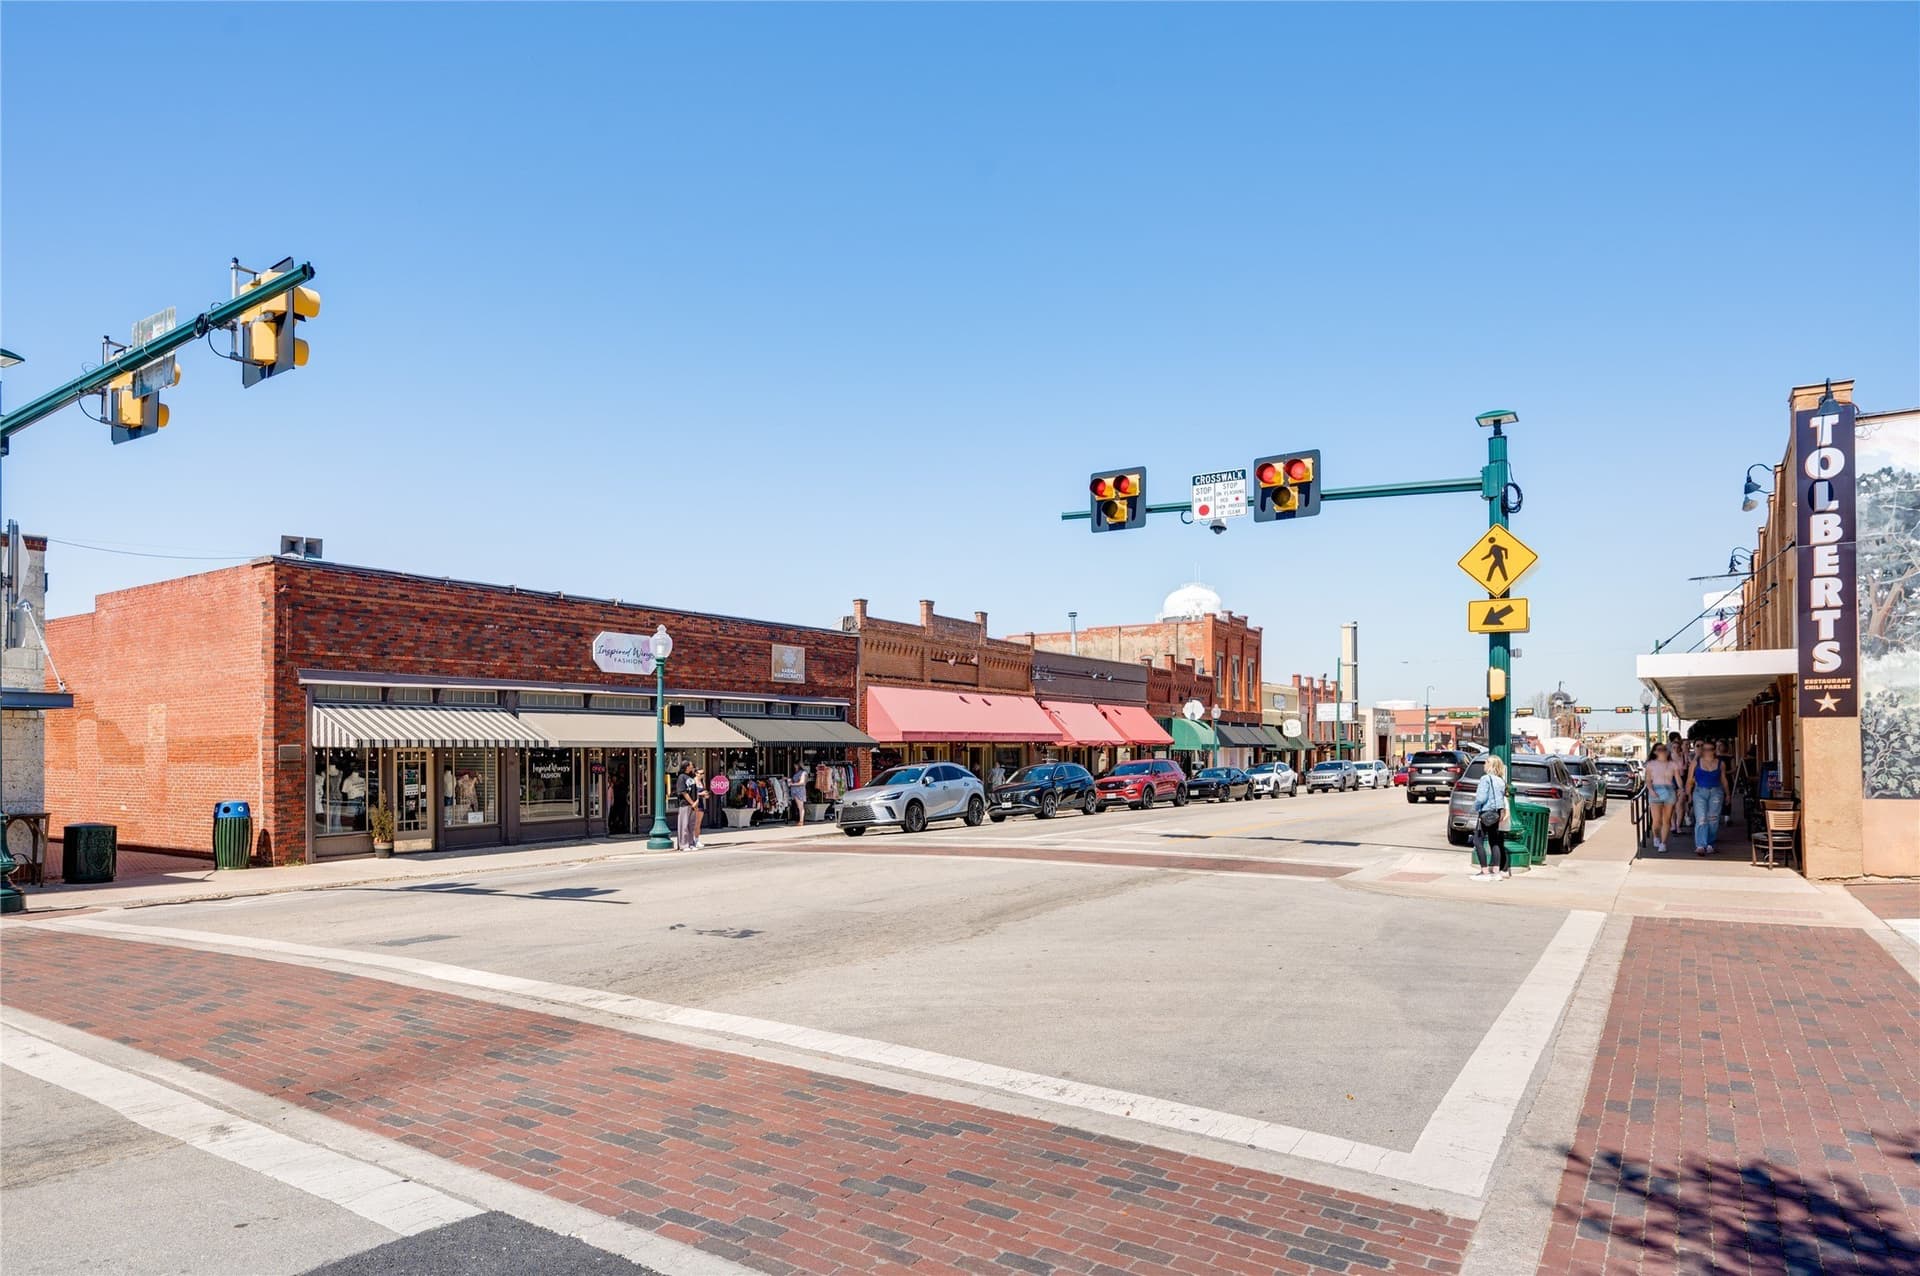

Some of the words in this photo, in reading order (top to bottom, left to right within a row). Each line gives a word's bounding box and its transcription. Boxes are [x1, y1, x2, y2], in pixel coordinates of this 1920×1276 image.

[1195, 471, 1243, 485] CROSSWALK
[1222, 482, 1238, 490] STOP
[1196, 487, 1212, 496] STOP
[1804, 414, 1845, 673] TOLBERTS
[596, 645, 633, 659] Inspired
[633, 648, 655, 662] Wings
[614, 657, 643, 665] FASHION
[711, 780, 729, 789] SHOP
